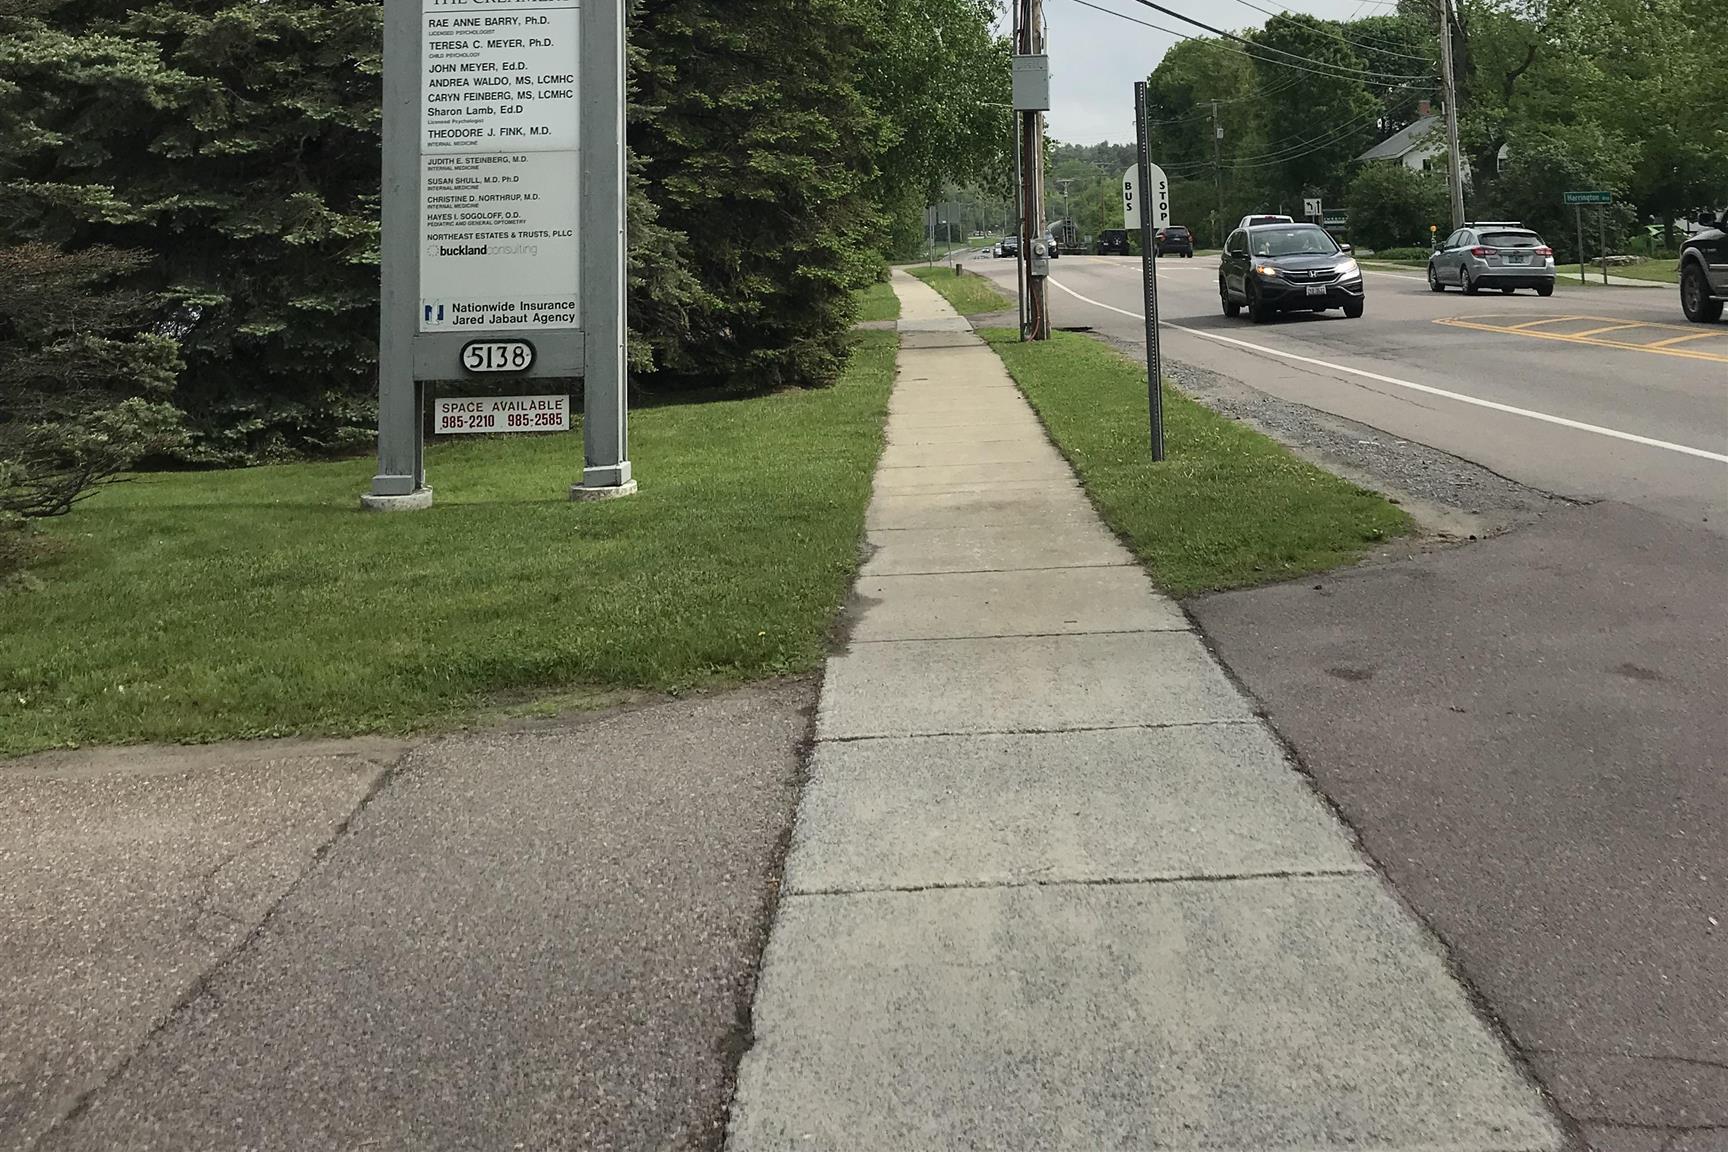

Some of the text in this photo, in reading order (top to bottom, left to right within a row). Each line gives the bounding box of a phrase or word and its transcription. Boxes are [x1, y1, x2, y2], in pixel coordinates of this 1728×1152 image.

[428, 16, 550, 28] RAE ANNE BARRY, Ph.D.
[429, 39, 554, 50] TERESA C. MEYER, Ph.D.
[429, 62, 528, 73] JOHN MEYER, Ed.D.
[429, 75, 574, 87] ANDREA WALDO, MS, LCMHC
[428, 90, 574, 102] CARYN FEINBERG, MS, LCMHC
[428, 105, 523, 116] Sharon Lamb, Ed.D
[428, 127, 552, 138] THEODORE J. FINK, M.D.
[465, 156, 510, 164] STEINBERG,
[427, 195, 467, 203] CHRISTINE
[1159, 181, 1167, 221] STOP
[460, 212, 504, 220] SOGOLOFF,
[518, 230, 551, 238] TRUSTS,
[452, 301, 575, 313] Nationwide Insurance
[452, 313, 575, 325] Jared Jabaut Agency
[470, 346, 525, 368] 5138
[442, 400, 563, 413] SPACE AVAILABLE
[442, 413, 562, 428] 985-2210 985-2585
